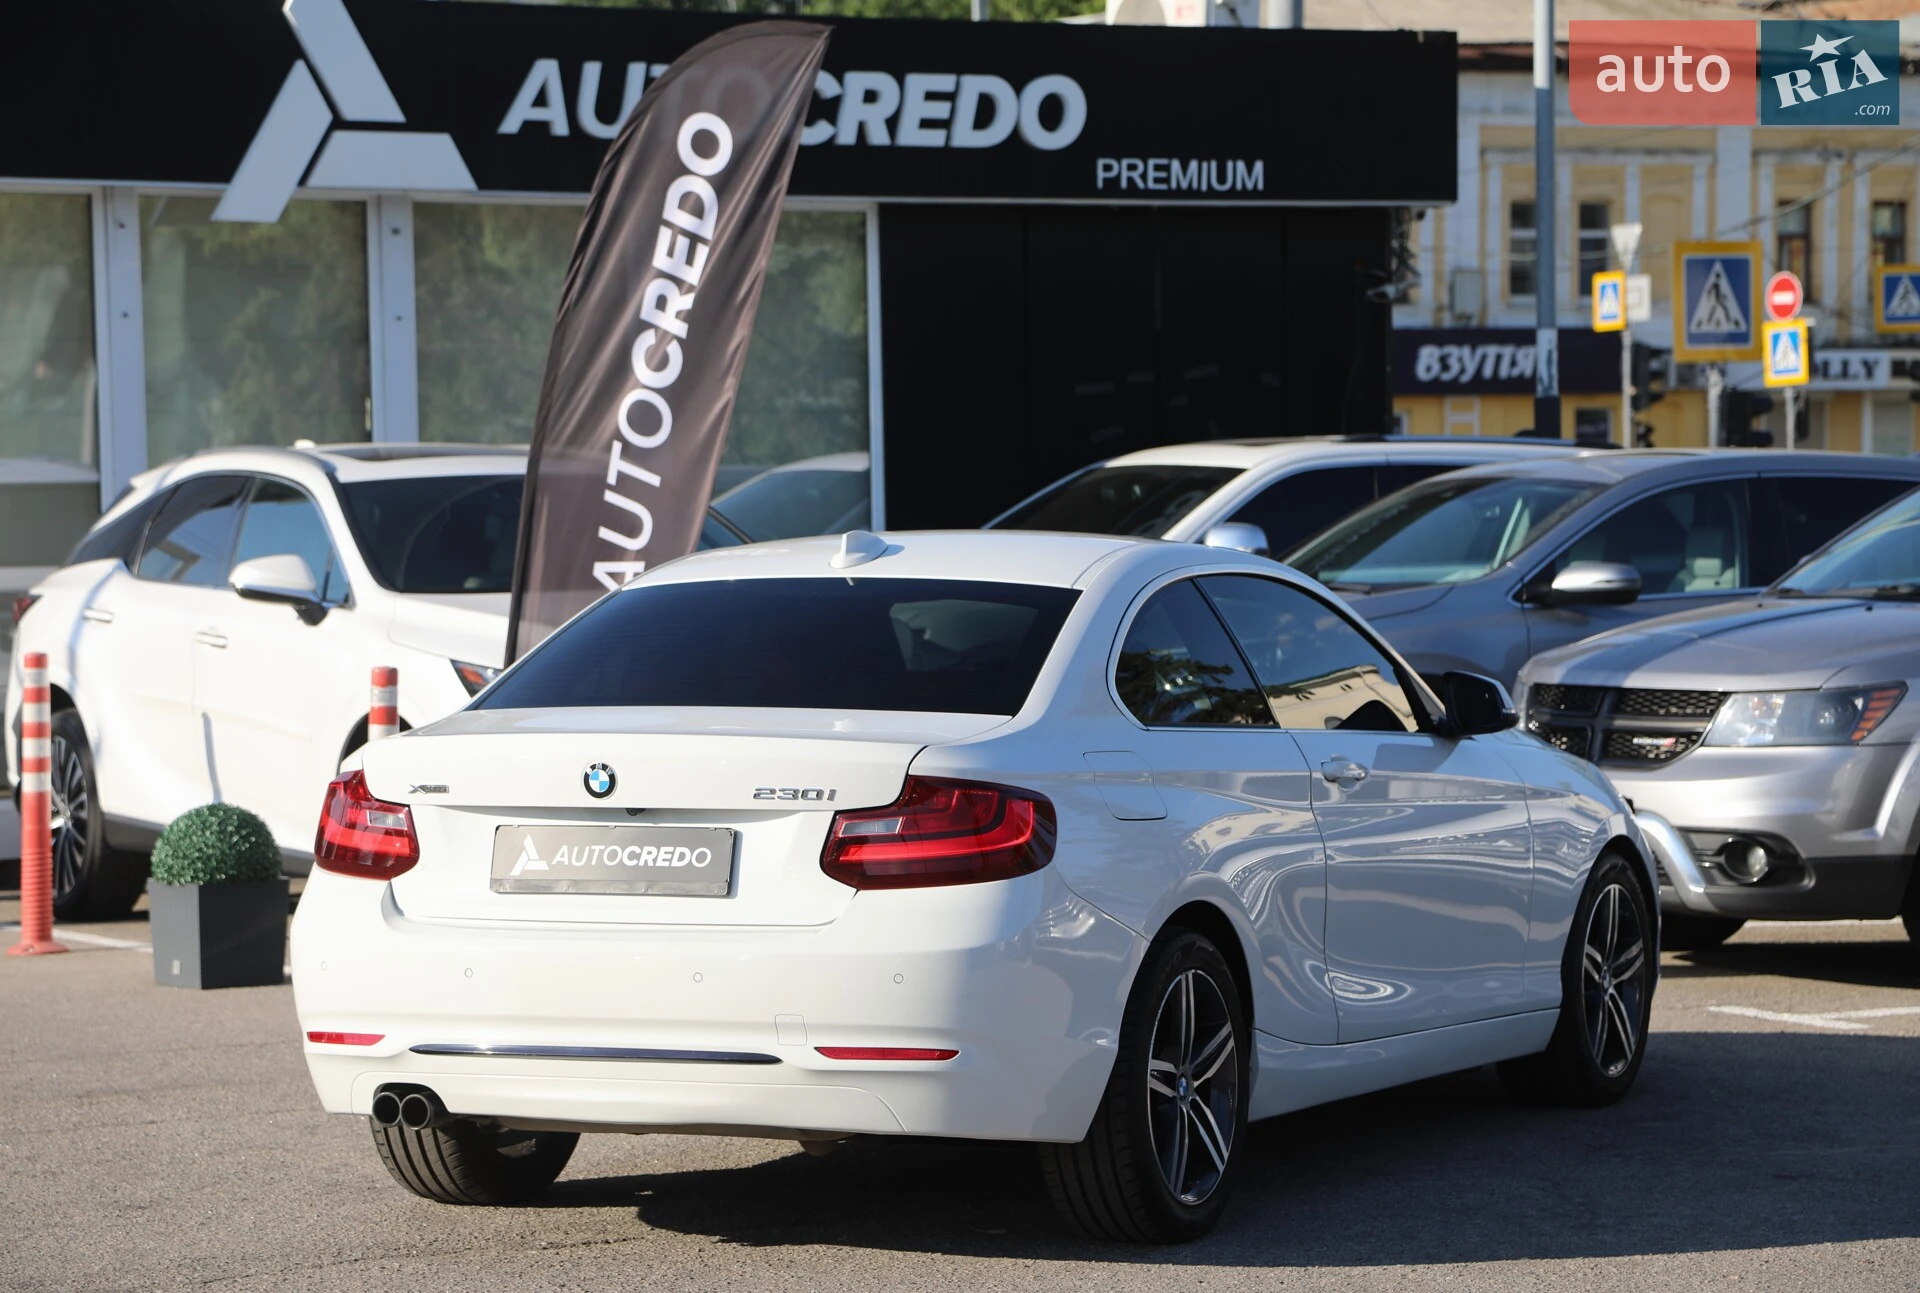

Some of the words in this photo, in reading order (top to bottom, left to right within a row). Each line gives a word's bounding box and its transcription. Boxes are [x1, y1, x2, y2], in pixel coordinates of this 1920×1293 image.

[1096, 158, 1264, 193] PREMIUM
[592, 112, 734, 593] AUTOCREDO
[551, 845, 712, 868] AUTOCREDO
